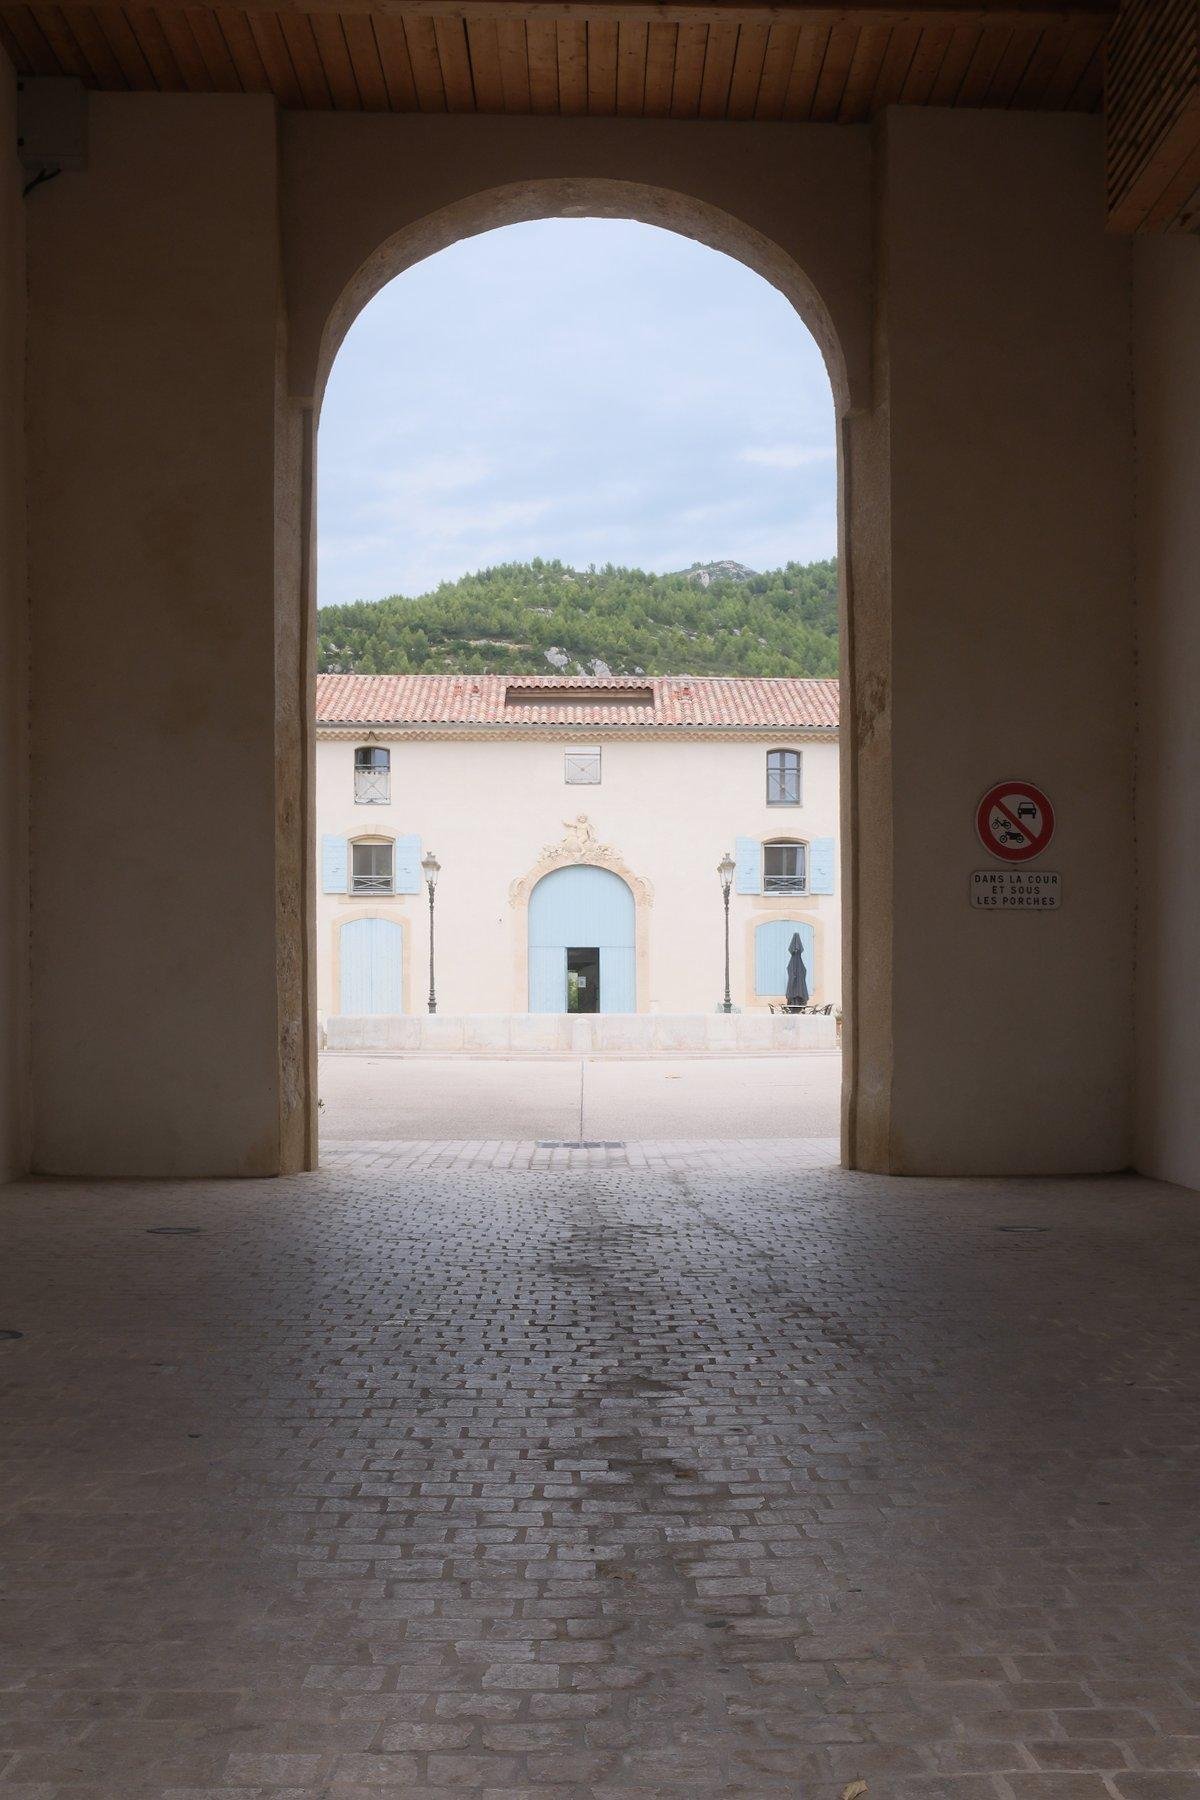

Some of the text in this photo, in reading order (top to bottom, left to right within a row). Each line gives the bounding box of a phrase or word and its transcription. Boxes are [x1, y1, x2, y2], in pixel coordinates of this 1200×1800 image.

[975, 874, 1057, 884] DANS LA COUR
[992, 886, 1040, 895] ET SOUS
[977, 896, 1055, 906] LES PORCHES
